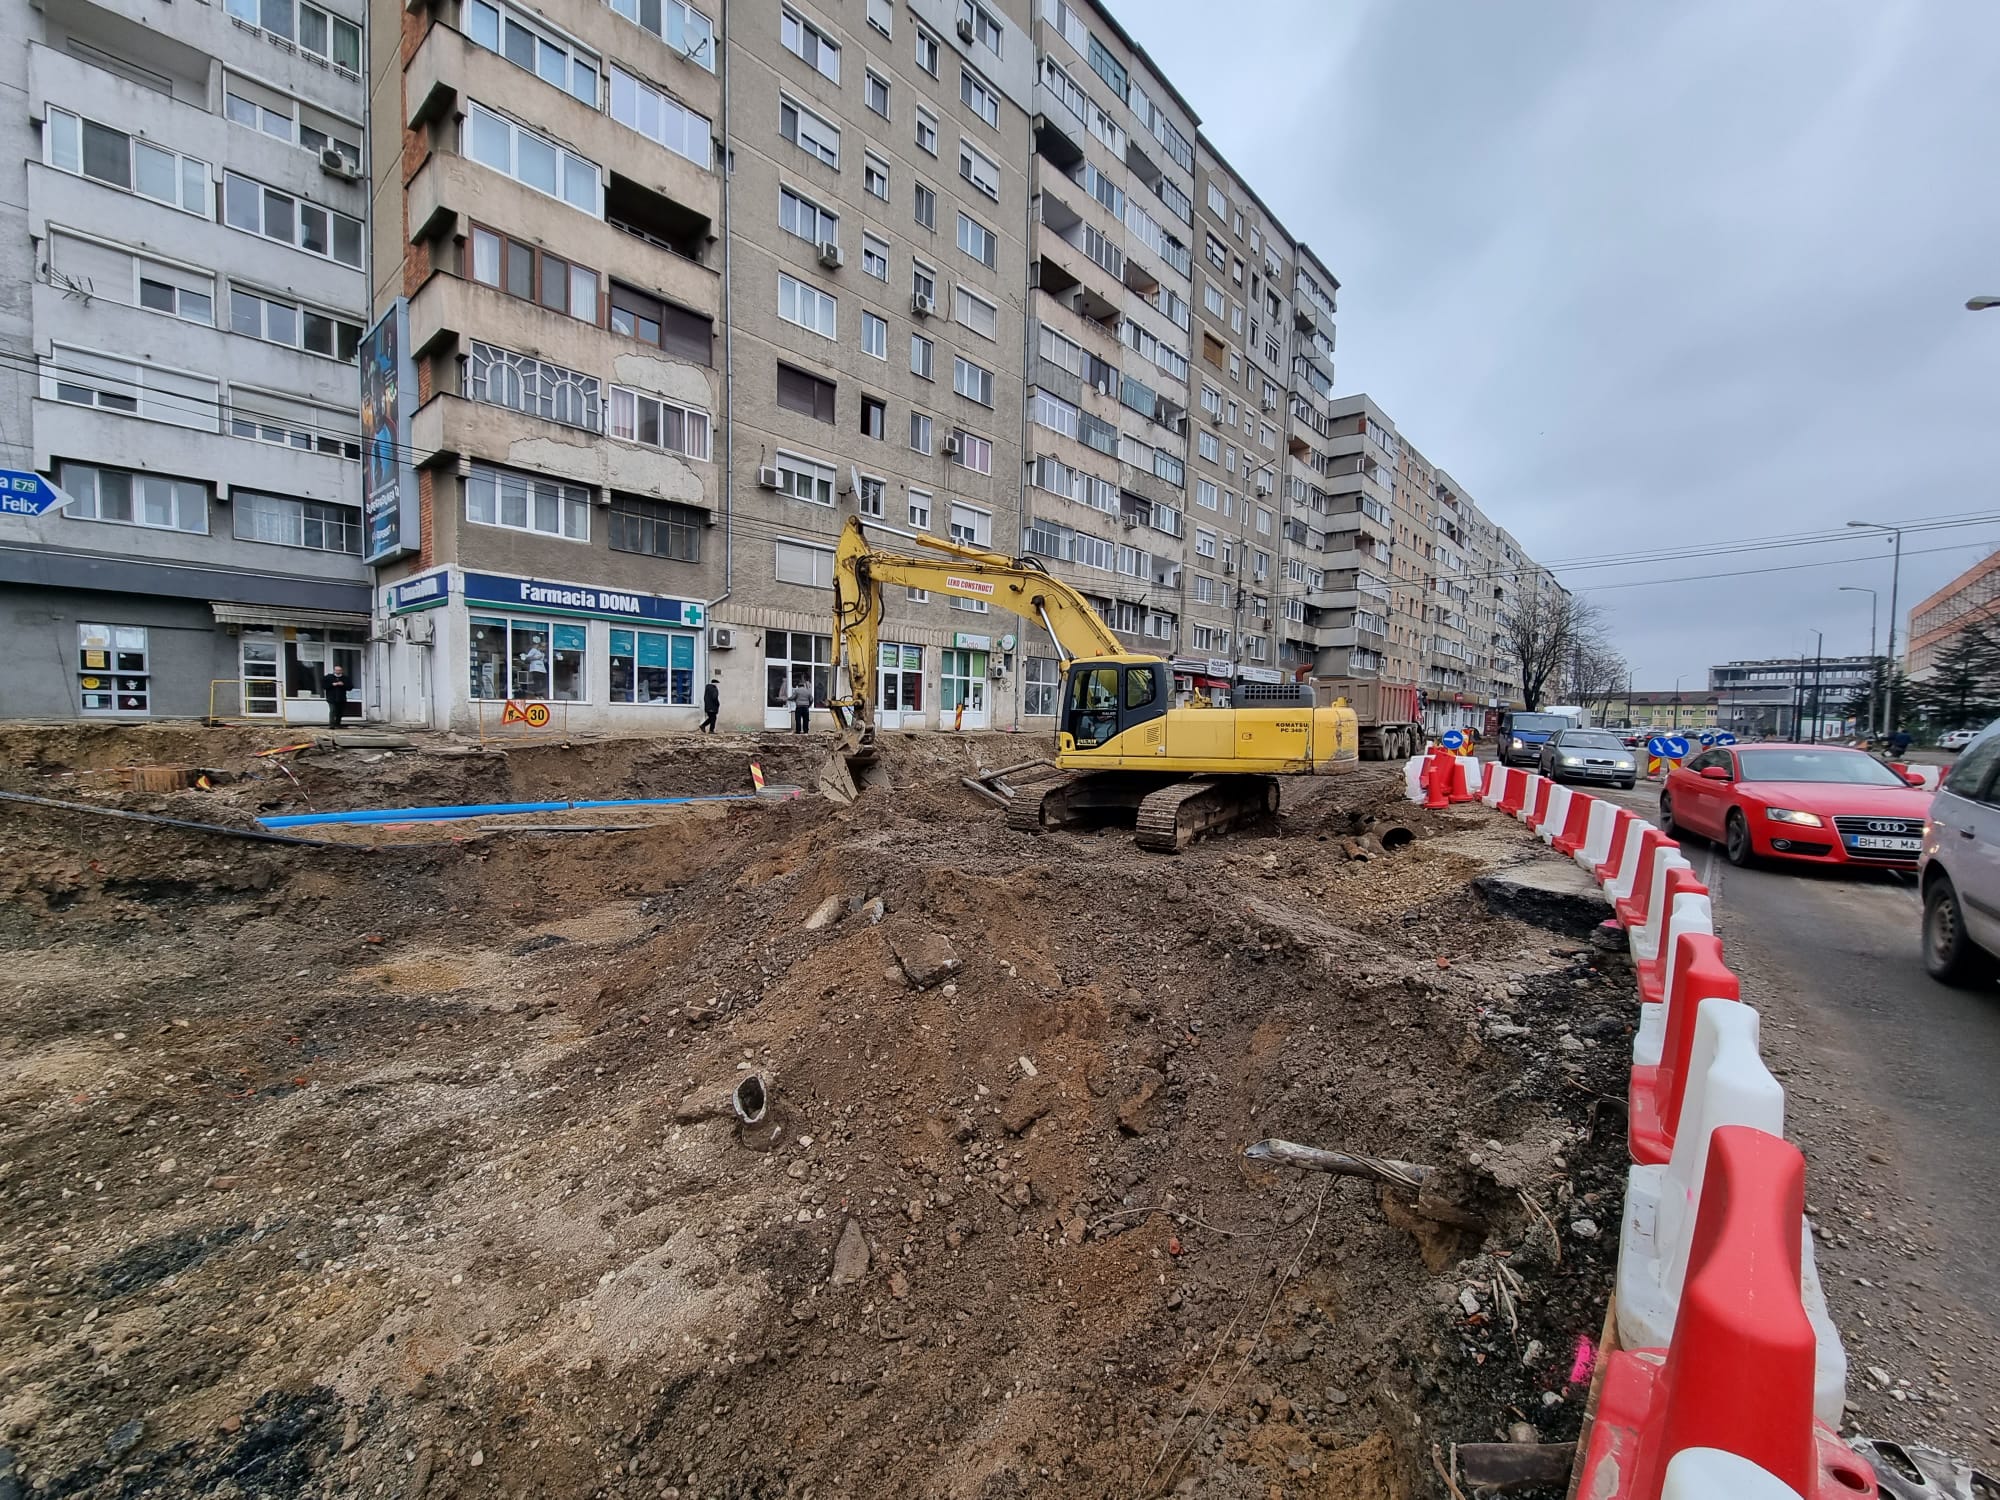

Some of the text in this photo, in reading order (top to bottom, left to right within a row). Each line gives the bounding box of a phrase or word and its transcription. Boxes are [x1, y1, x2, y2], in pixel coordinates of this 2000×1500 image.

[13, 479, 36, 492] E79
[2, 494, 39, 514] Felix
[960, 580, 993, 593] CONSTRUCT
[520, 582, 640, 613] Farmacia DONA
[530, 709, 545, 721] 30
[1859, 837, 1878, 848] BH
[1881, 839, 1894, 849] 12
